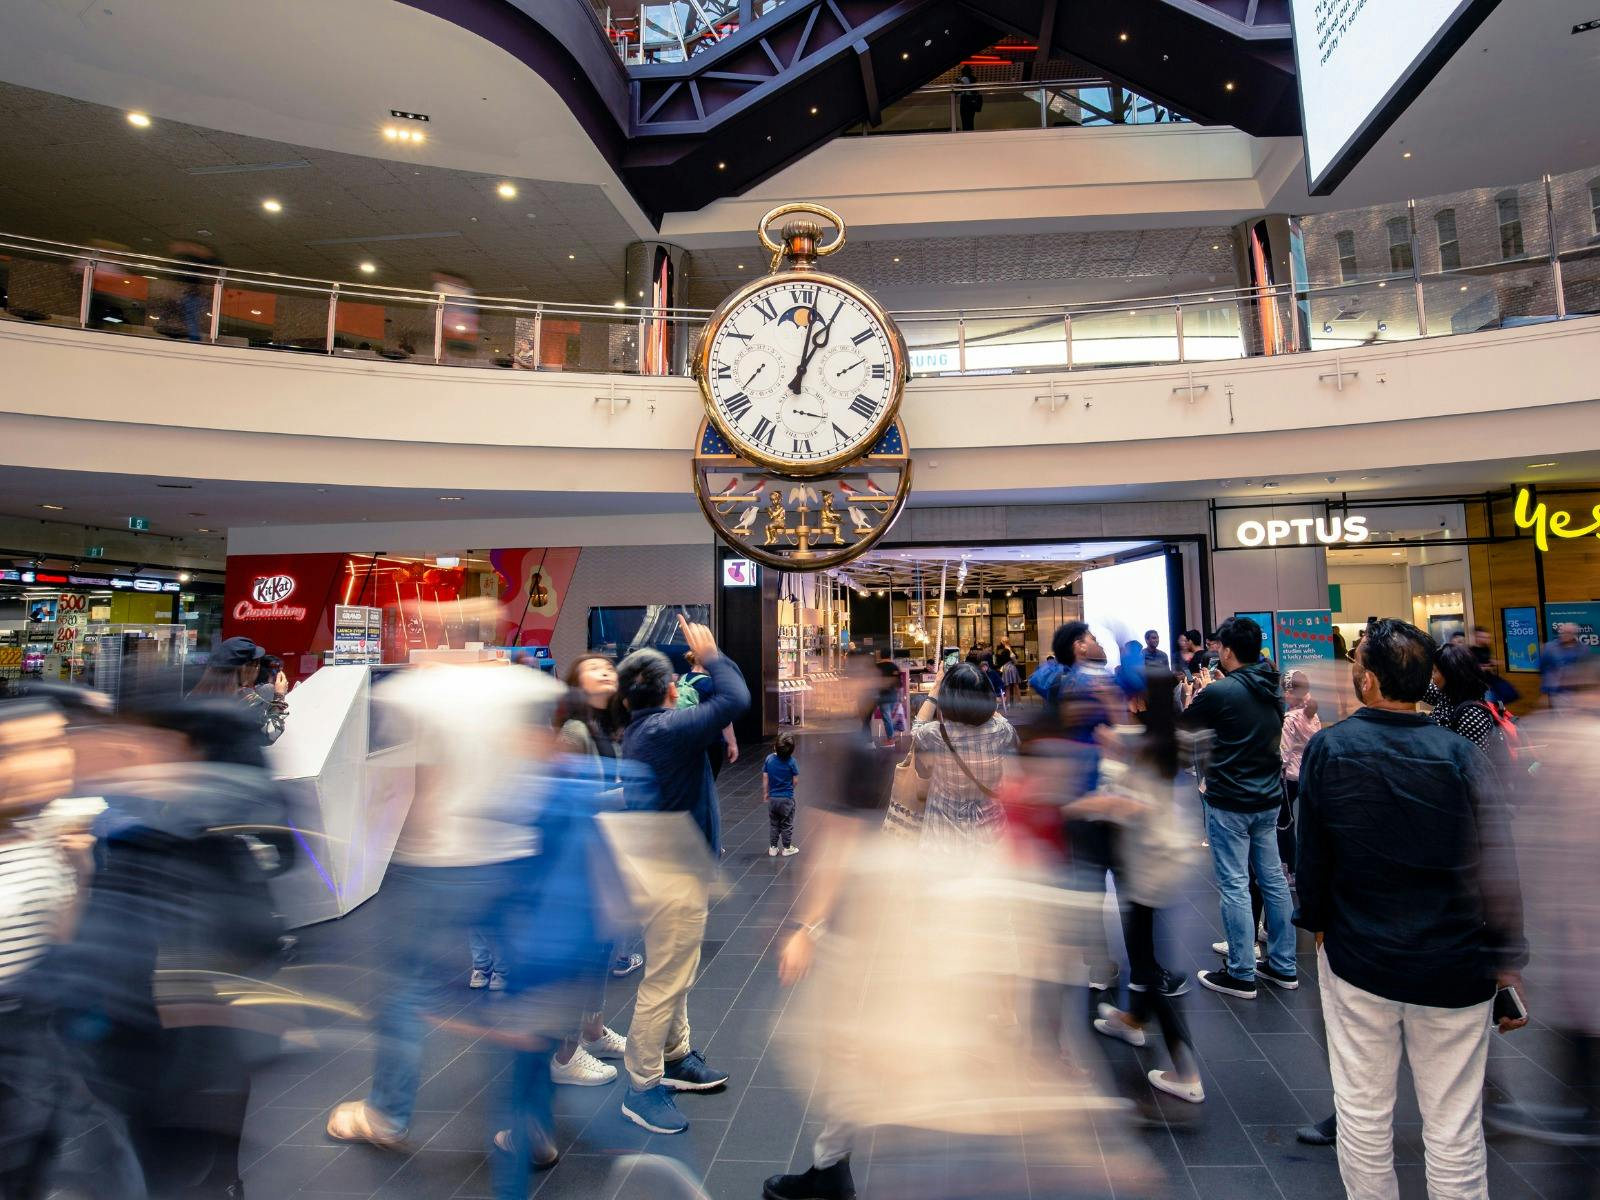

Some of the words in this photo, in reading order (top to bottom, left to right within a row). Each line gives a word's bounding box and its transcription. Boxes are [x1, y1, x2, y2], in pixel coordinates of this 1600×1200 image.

[1316, 17, 1326, 34] the
[1318, 13, 1339, 50] walked
[1320, 35, 1338, 67] reality
[1339, 19, 1346, 38] TV
[1348, 0, 1367, 26] serie
[751, 296, 778, 326] XI
[725, 322, 754, 347] X
[850, 326, 876, 347] II
[871, 364, 885, 380] III
[831, 422, 851, 446] V
[1236, 515, 1369, 547] OPTUS
[257, 577, 289, 602] KitKat
